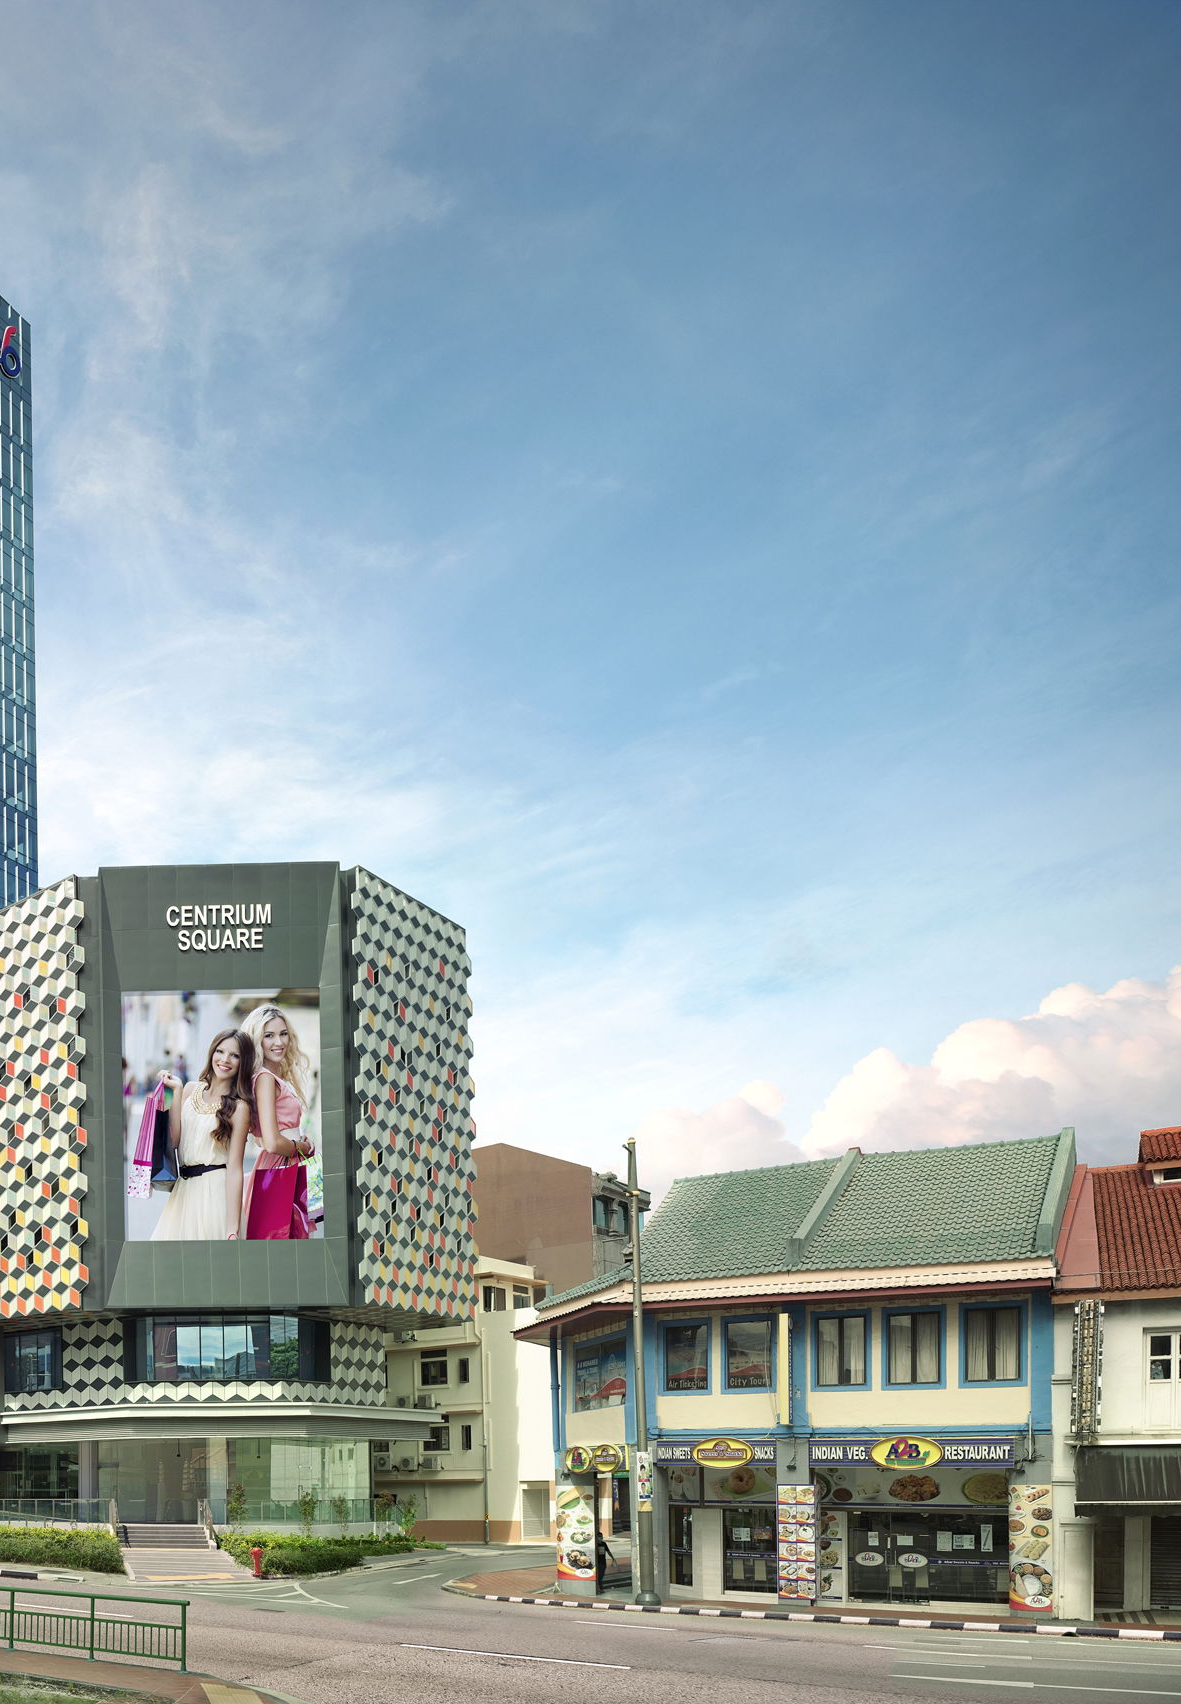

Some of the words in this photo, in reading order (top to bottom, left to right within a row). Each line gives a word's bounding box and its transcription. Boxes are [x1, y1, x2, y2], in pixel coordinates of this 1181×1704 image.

[166, 904, 272, 927] CENTRIUM
[178, 927, 264, 951] SQUARE
[668, 1380, 678, 1389] Air
[679, 1379, 707, 1389] Ticketing
[730, 1378, 747, 1387] City
[658, 1447, 673, 1459] NDIAN
[673, 1447, 691, 1459] SWEETS
[755, 1447, 774, 1459] SNACKS
[812, 1447, 843, 1460] INDIAN
[848, 1447, 869, 1460] VEG.
[886, 1439, 921, 1459] A2B
[945, 1446, 1010, 1460] RESTAURANT
